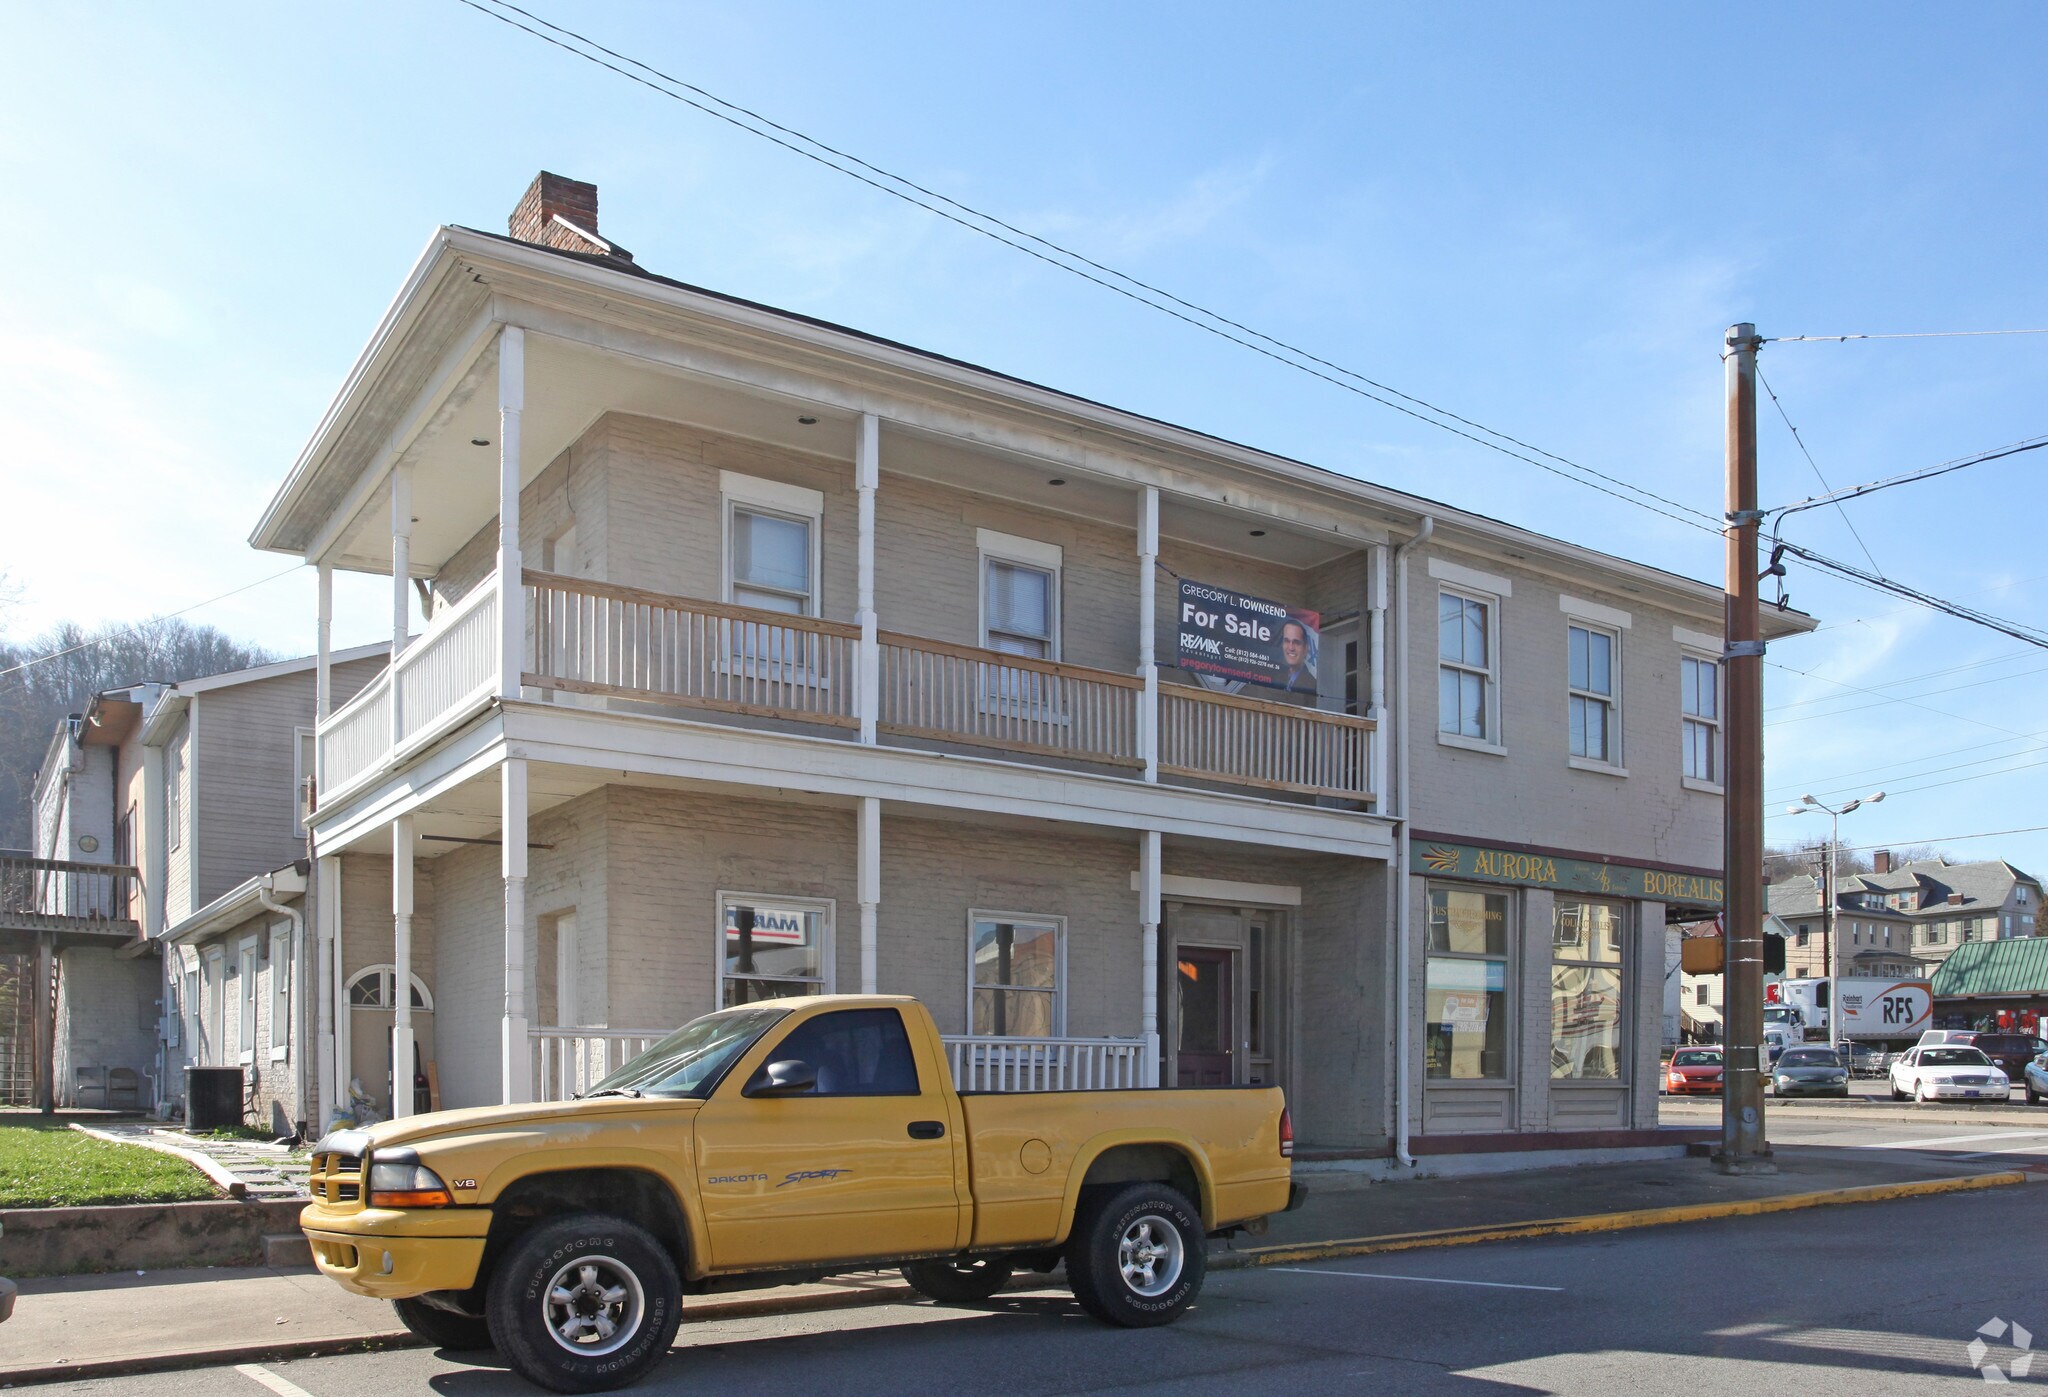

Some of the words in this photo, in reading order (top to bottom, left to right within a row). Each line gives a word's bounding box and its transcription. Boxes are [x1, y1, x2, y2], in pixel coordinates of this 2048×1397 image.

[1182, 584, 1228, 604] GREGORY
[1230, 596, 1237, 607] L.
[1239, 598, 1287, 618] TOWNSEND
[1182, 602, 1218, 629] For
[1224, 613, 1271, 642] Sale
[1180, 632, 1221, 655] RE/MAX
[1181, 657, 1272, 683] gregorytownsend.com
[1473, 850, 1558, 882] AURORA
[1643, 871, 1723, 902] BOREALIS
[1883, 997, 1913, 1024] RFS
[453, 1179, 477, 1188] V8
[708, 1173, 768, 1184] DAKOTA
[776, 1169, 853, 1188] SPORT
